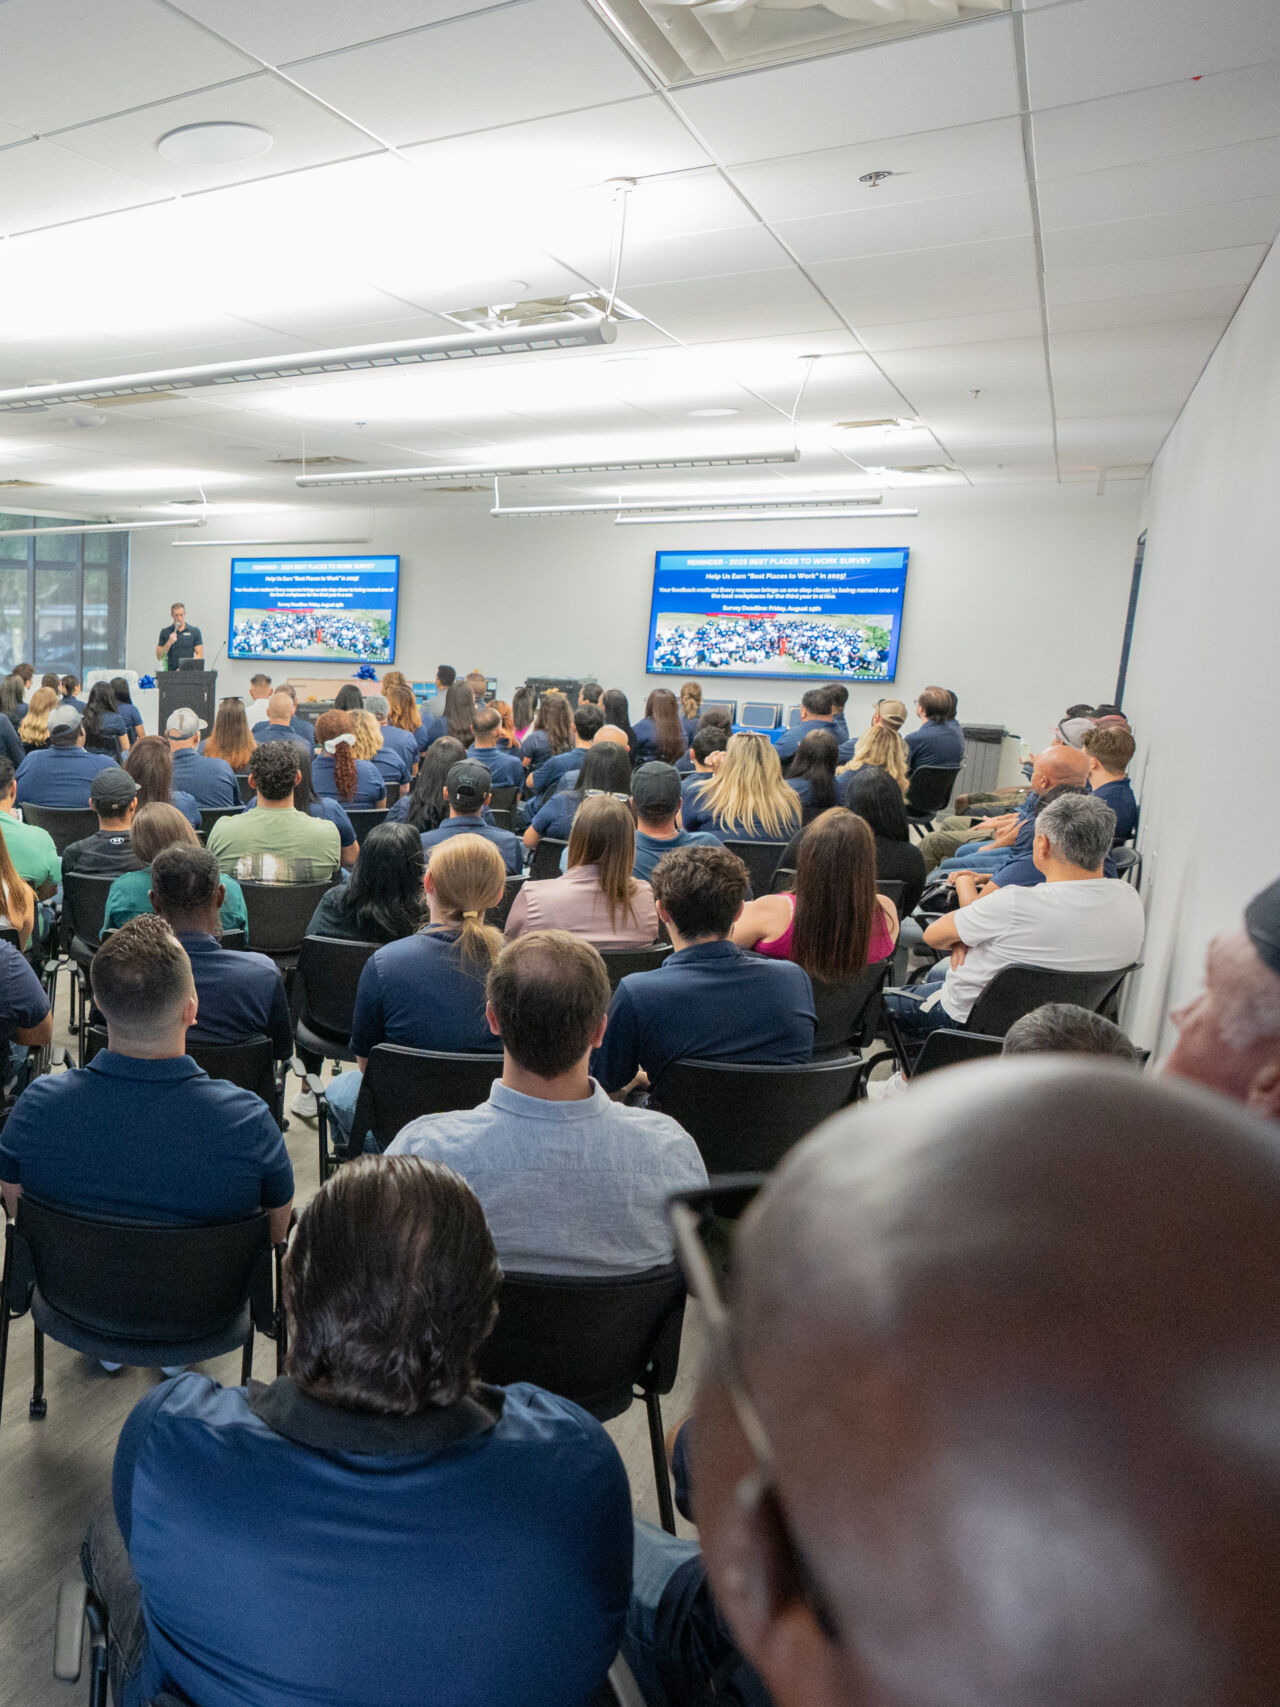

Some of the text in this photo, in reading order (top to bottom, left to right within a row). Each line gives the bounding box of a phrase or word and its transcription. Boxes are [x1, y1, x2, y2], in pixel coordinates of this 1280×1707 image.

[687, 558, 723, 566] REMINDER
[813, 557, 837, 565] WORK
[705, 573, 721, 581] Help
[788, 605, 808, 613] August
